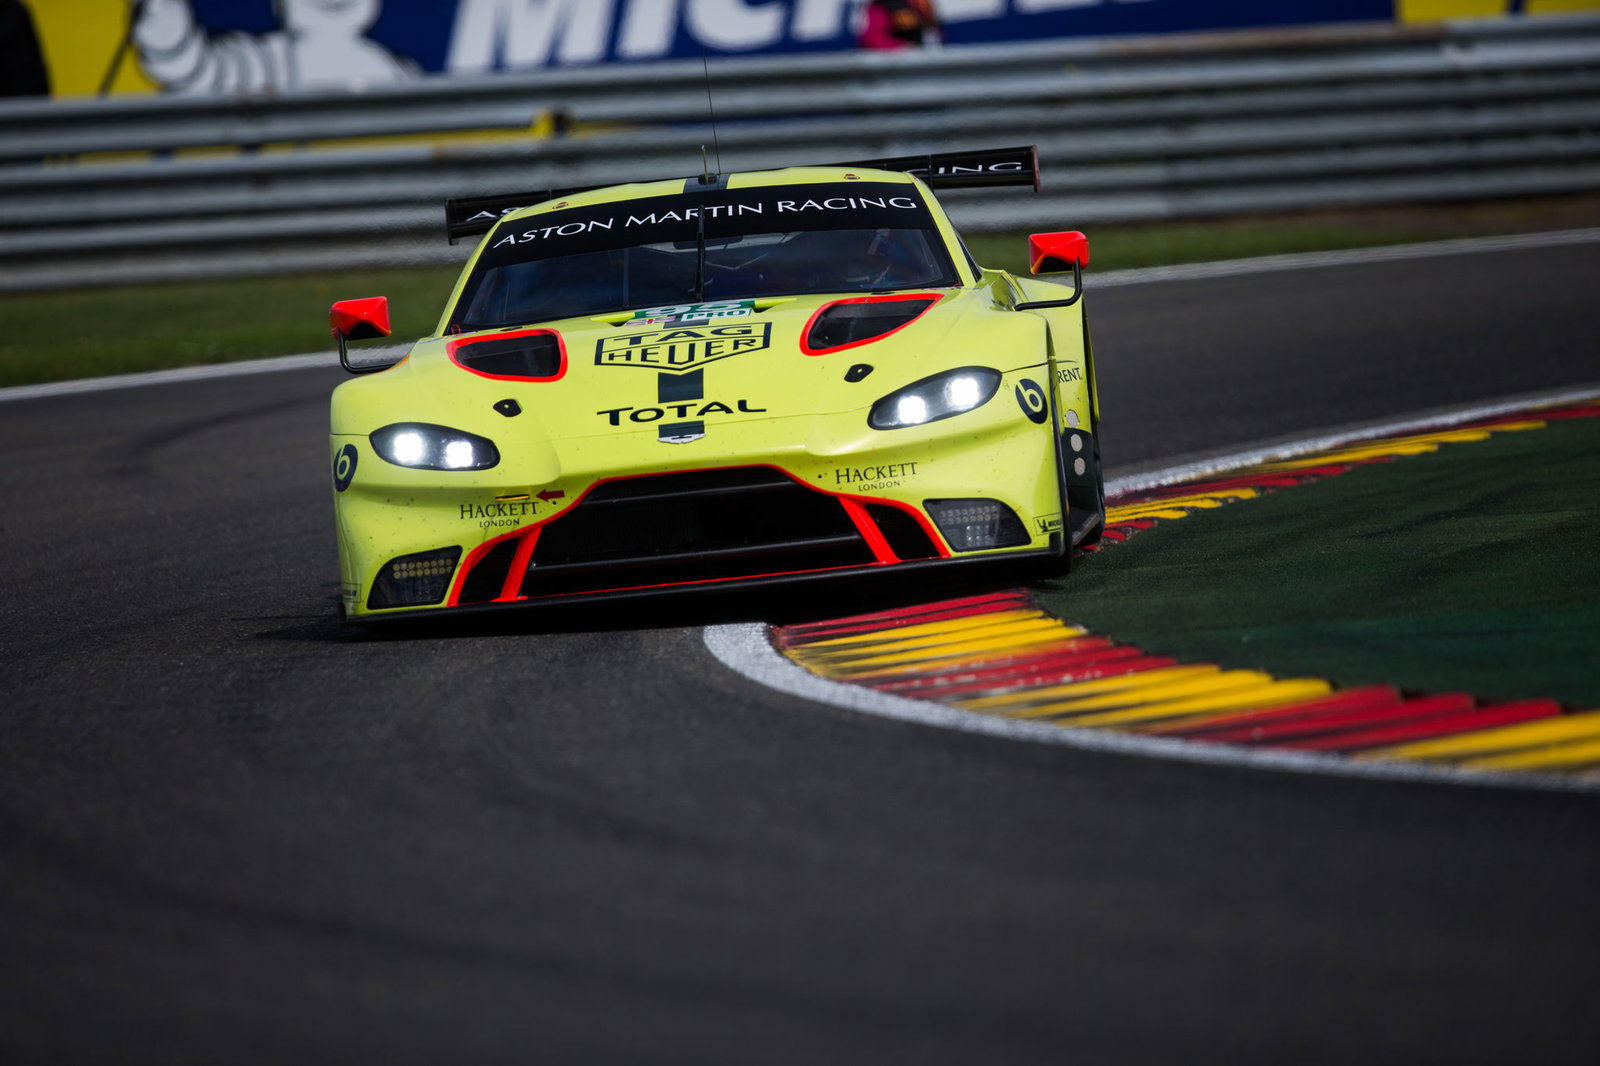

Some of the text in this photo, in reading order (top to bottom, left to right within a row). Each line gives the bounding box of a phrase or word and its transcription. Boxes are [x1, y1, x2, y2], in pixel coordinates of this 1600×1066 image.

[493, 197, 917, 248] ASTON MARTIN RACING
[686, 309, 746, 320] PRO
[613, 325, 752, 345] TAG
[608, 338, 757, 365] HEUER
[597, 400, 767, 426] TOTAL
[835, 462, 918, 484] HACKETT
[859, 481, 901, 492] LONDON
[460, 501, 539, 519] HACKETT
[479, 518, 520, 528] LONDON
